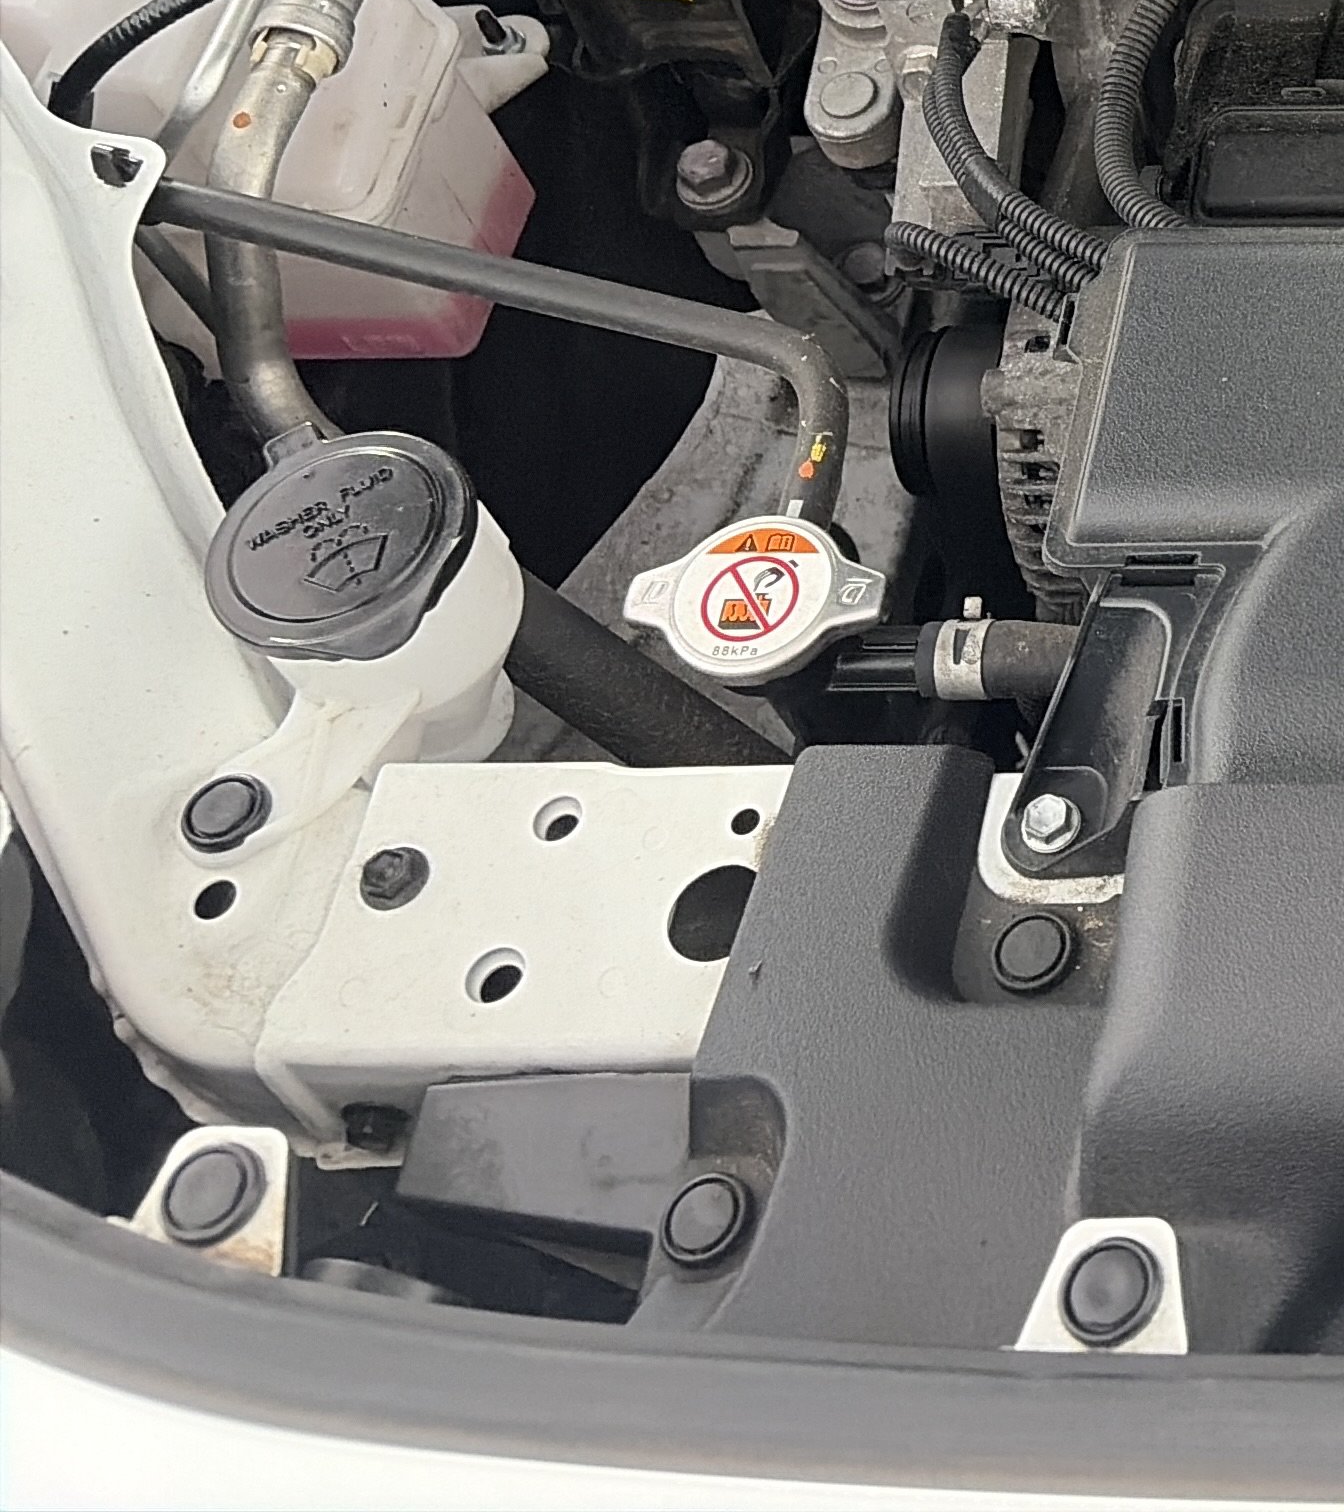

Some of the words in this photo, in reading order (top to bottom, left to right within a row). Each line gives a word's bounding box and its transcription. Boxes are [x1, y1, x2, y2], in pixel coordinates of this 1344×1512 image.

[247, 501, 329, 551] WASHER
[339, 466, 393, 503] FLUID
[302, 504, 350, 539] ONLY
[712, 645, 758, 657] 88kPa
